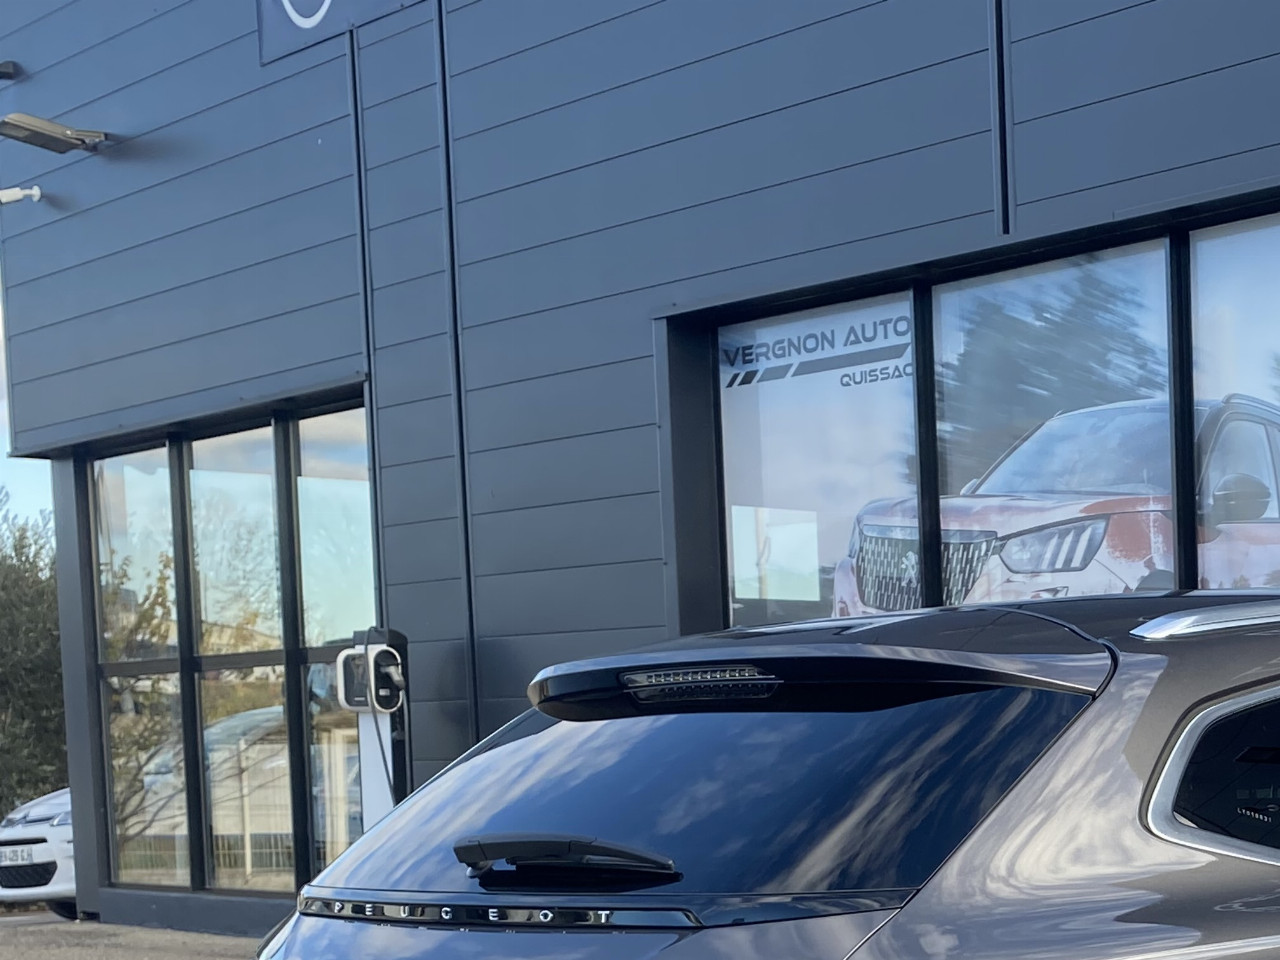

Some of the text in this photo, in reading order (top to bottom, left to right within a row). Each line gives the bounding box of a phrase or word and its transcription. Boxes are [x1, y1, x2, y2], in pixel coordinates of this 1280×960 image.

[722, 315, 912, 367] VERGNON AUTO
[334, 901, 610, 923] PEUGEOT
